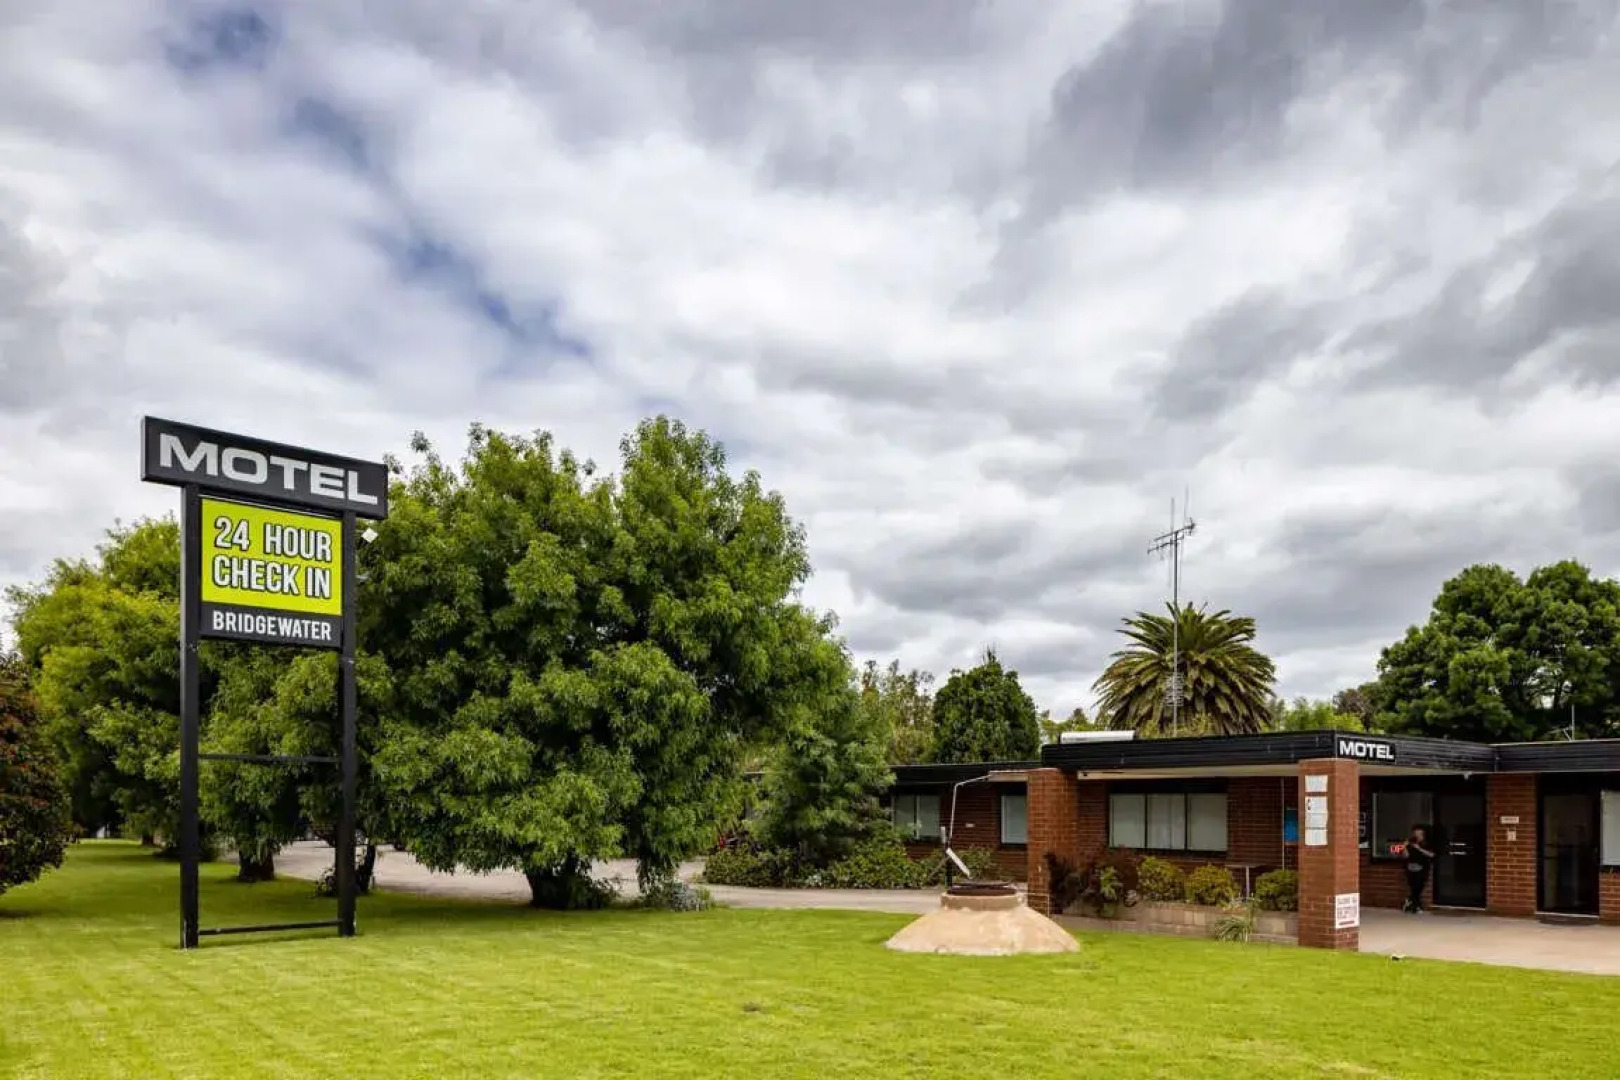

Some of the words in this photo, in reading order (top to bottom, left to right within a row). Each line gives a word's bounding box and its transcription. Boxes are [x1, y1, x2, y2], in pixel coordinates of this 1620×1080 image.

[159, 433, 377, 505] MOTEL
[214, 516, 250, 551] 24
[264, 522, 332, 562] HOUR
[213, 555, 300, 595] CHECK
[306, 567, 331, 599] IN
[213, 610, 331, 641] BRIDGEWATER
[1339, 740, 1394, 760] MOTEL
